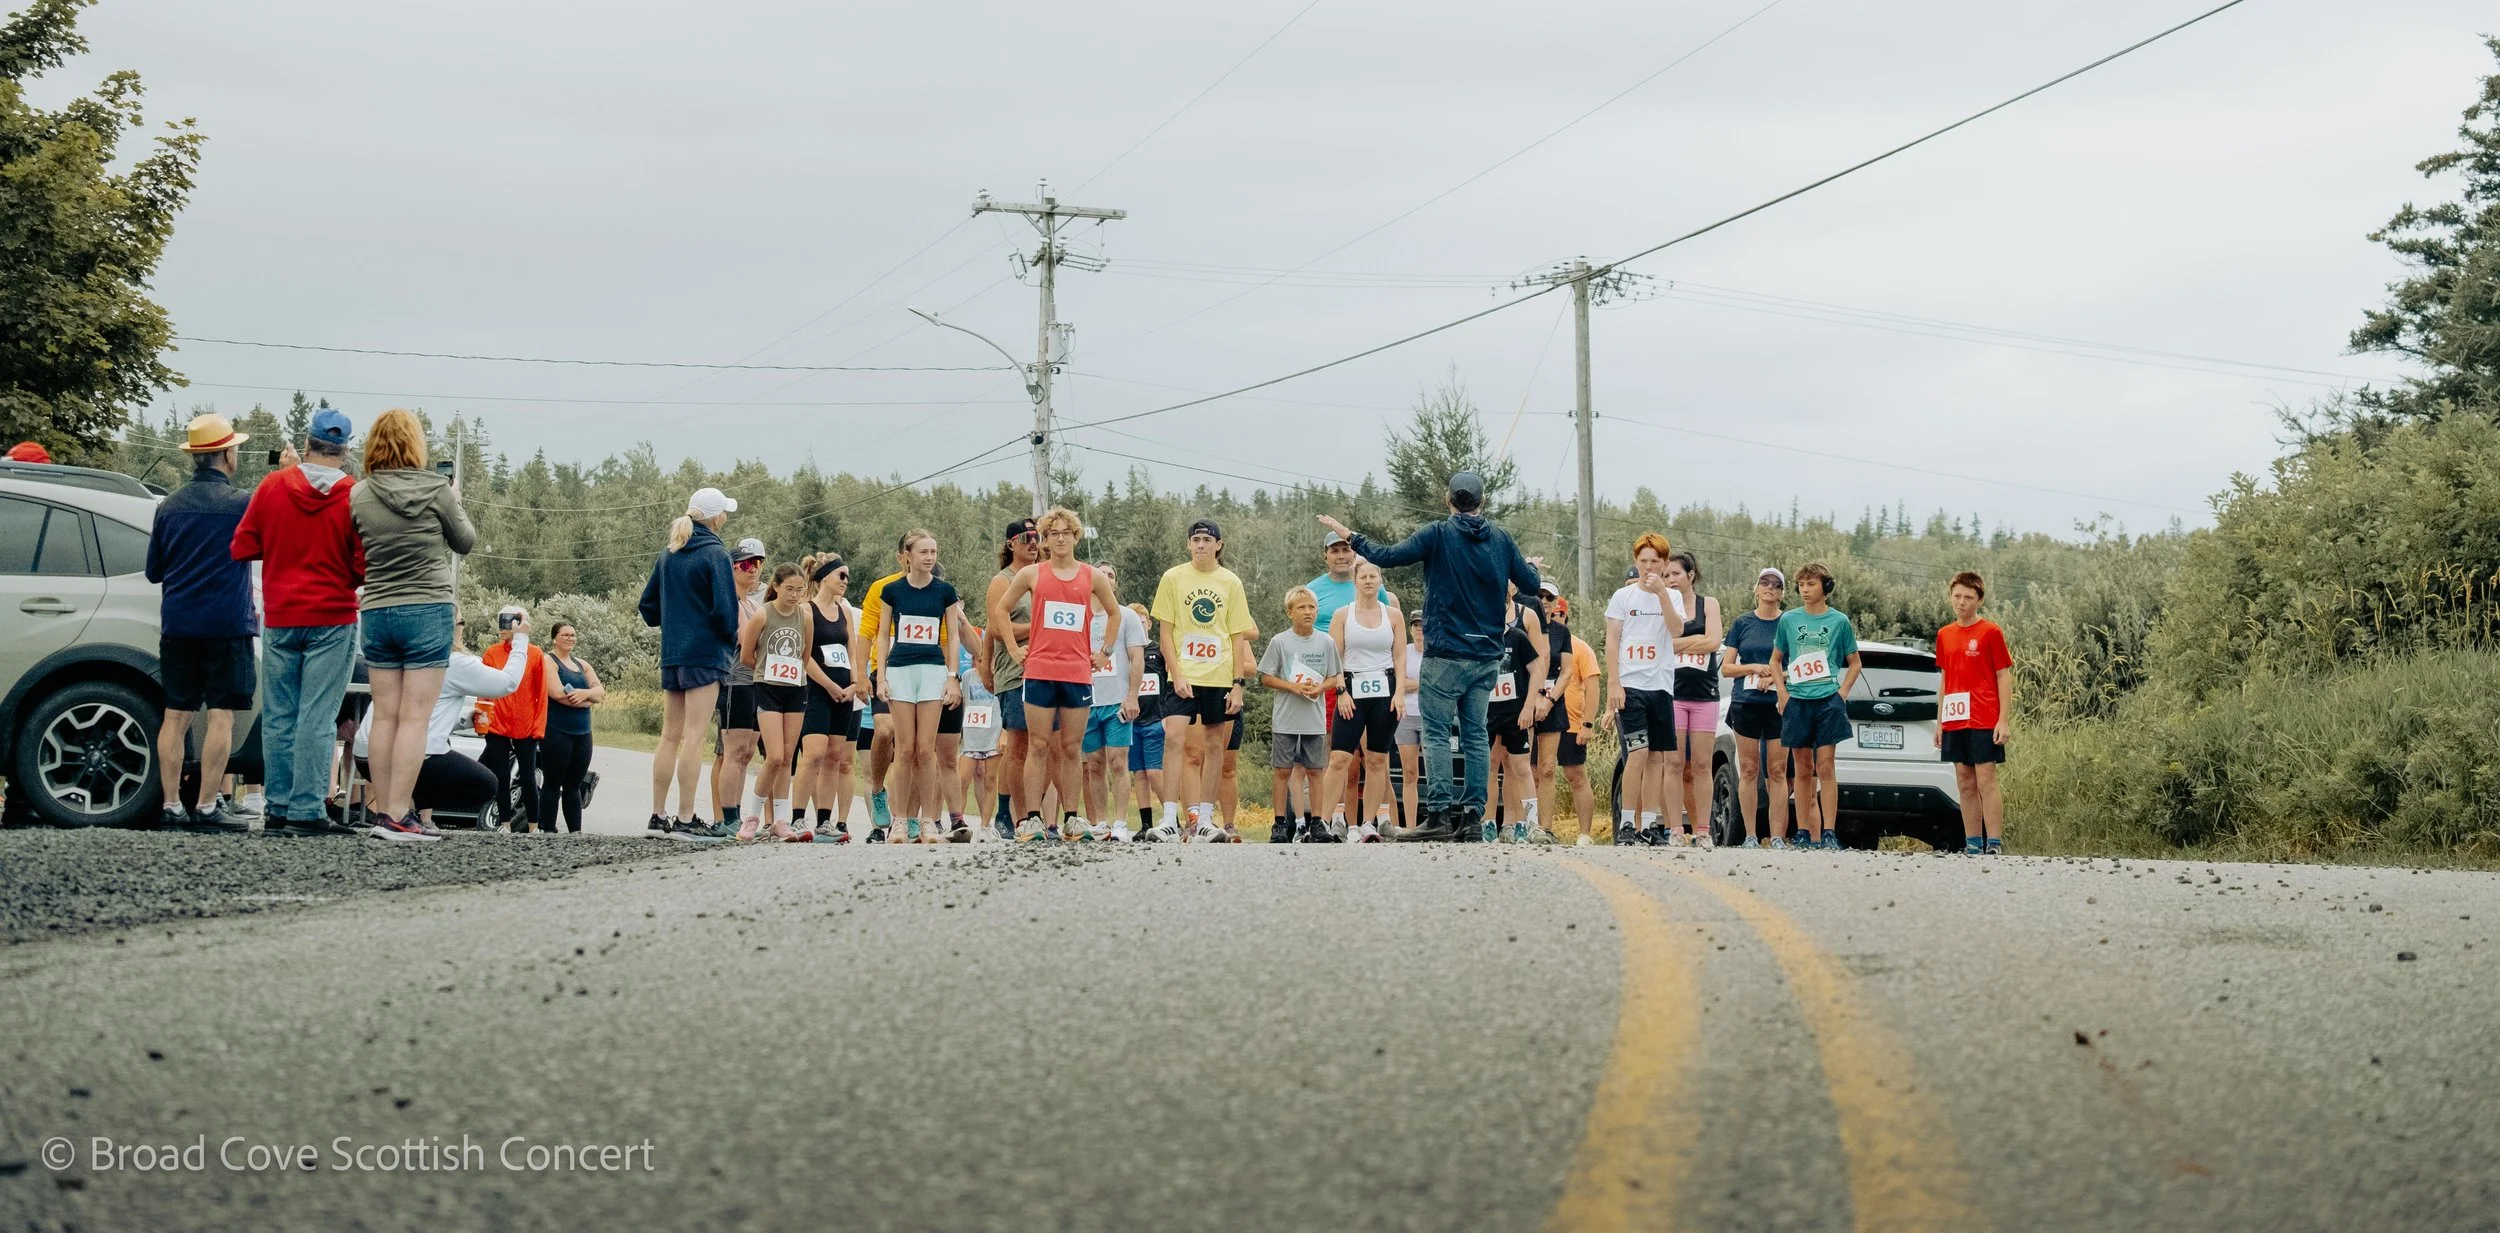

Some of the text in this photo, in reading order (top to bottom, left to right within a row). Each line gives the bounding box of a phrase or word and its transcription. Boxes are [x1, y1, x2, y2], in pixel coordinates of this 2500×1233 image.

[1184, 588, 1224, 609] GET ACTIVE
[1053, 611, 1076, 626] 63
[904, 623, 933, 640] 121
[1187, 641, 1217, 658] 126
[1627, 645, 1656, 660] 115
[831, 651, 846, 664] 90
[1677, 653, 1705, 666] 118
[771, 663, 798, 680] 129
[1793, 660, 1824, 678] 136
[1140, 680, 1156, 692] 22
[1360, 680, 1381, 693] 65
[1494, 682, 1511, 697] 16
[1944, 701, 1966, 717] 130
[967, 712, 987, 725] 131
